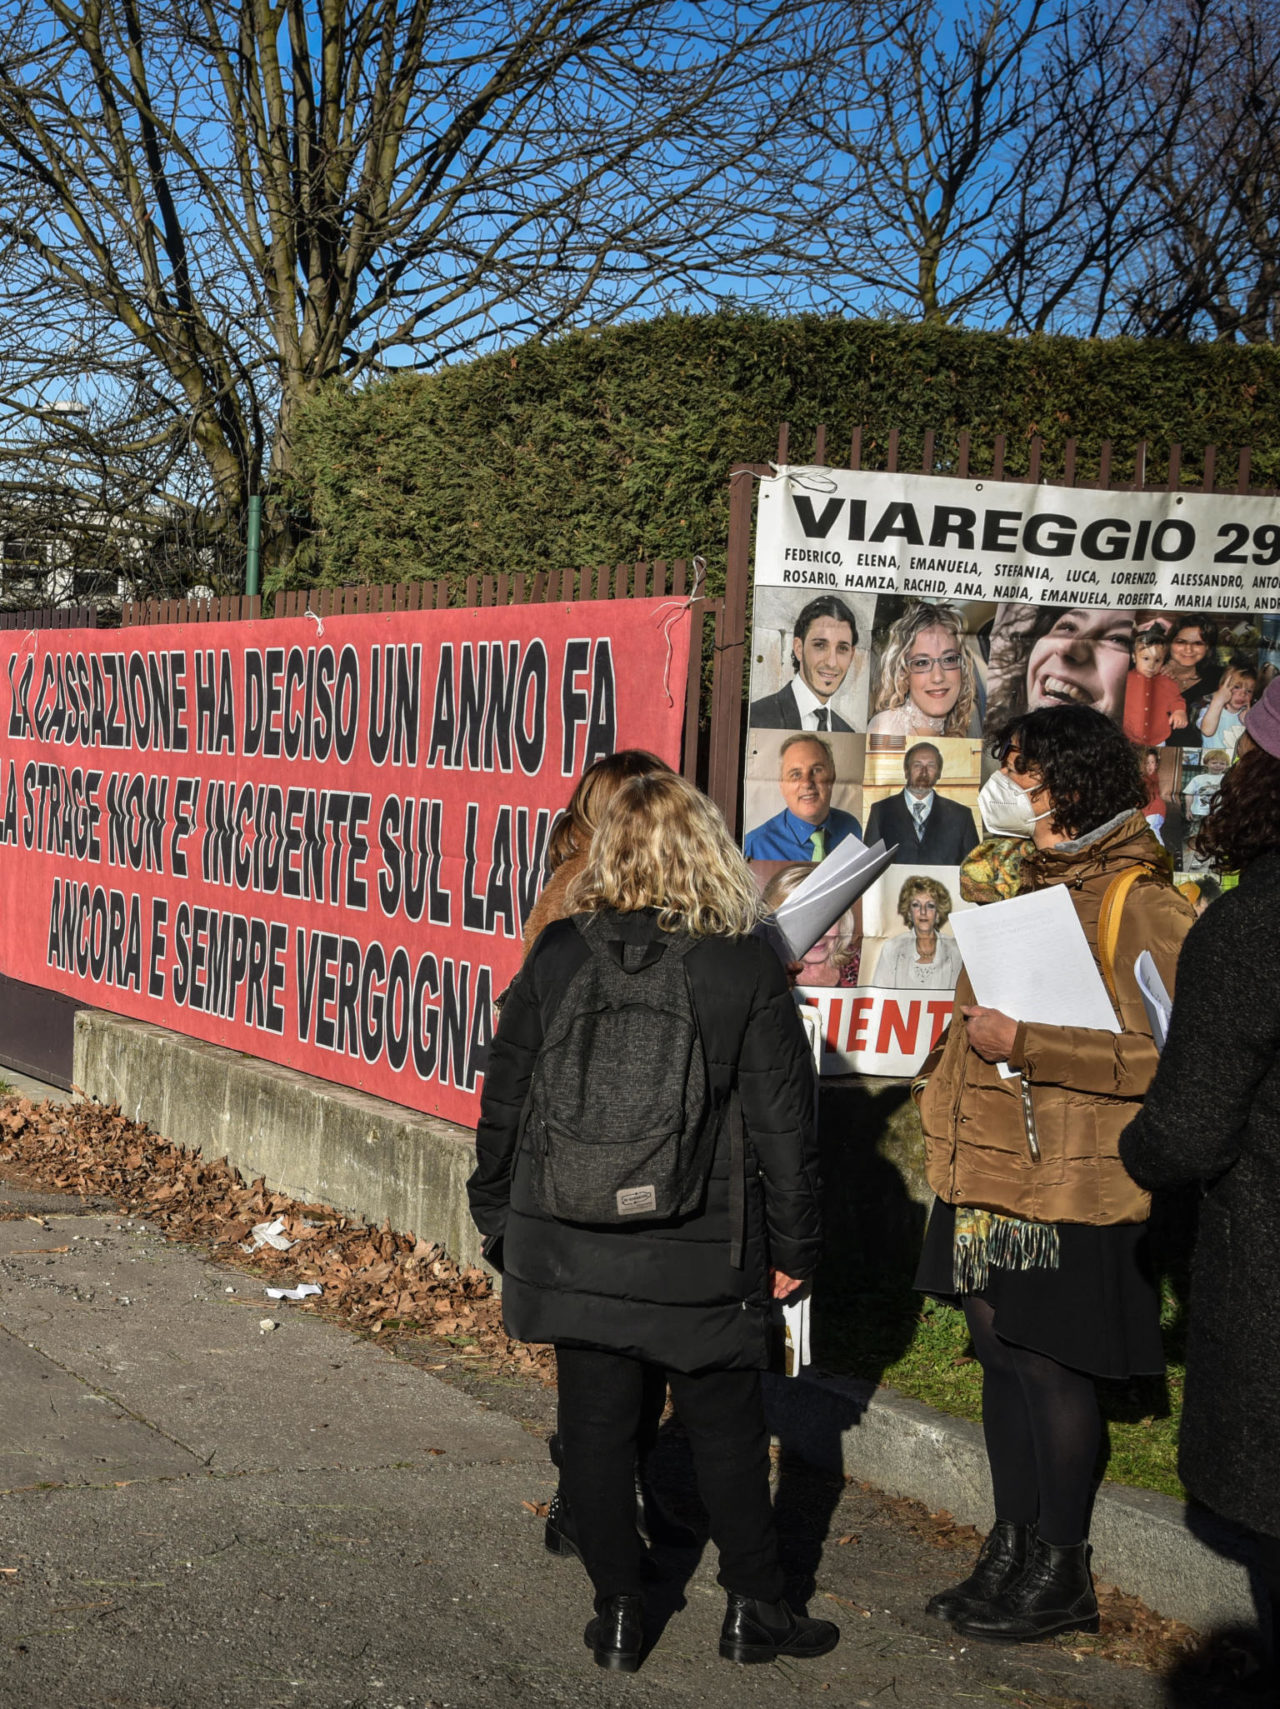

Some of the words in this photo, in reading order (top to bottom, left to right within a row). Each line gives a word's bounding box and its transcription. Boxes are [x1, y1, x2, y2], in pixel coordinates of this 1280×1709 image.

[792, 495, 1196, 562] VIAREGGIO
[1213, 523, 1280, 566] 29
[783, 570, 838, 588] ROSARIO,
[845, 574, 899, 592] HAMZA,
[903, 578, 948, 595] RACHID,
[954, 582, 987, 599] ANA,
[993, 585, 1033, 602] NADIA,
[1040, 588, 1111, 607] EMANUELA,
[1116, 593, 1168, 608] ROBERTA,
[1174, 594, 1213, 608] MARIA
[1217, 595, 1250, 610] LUISA,
[785, 548, 843, 566] FEDERICO,
[857, 553, 900, 570] ELENA,
[910, 557, 982, 576] EMANUELA,
[994, 563, 1054, 583] STEFANIA,
[1066, 569, 1100, 585] LUCA,
[1111, 571, 1158, 586] LORENZO,
[1170, 573, 1244, 589] ALESSANDRO,
[1252, 576, 1280, 589] ANTO
[8, 652, 35, 740] LA
[34, 650, 188, 753] CASSAZIONE
[194, 649, 235, 756] HA
[243, 643, 360, 765] DECISO
[368, 643, 422, 767] UN
[426, 637, 548, 776] ANNO
[561, 637, 616, 777] FA
[23, 760, 104, 864] STRAGE
[106, 772, 169, 875] NON
[170, 777, 201, 878] E'
[202, 779, 371, 911] INCIDENTE
[377, 794, 451, 926] SUL
[462, 802, 566, 940] LAV
[47, 876, 141, 994] ANCORA
[148, 897, 168, 999] E
[172, 901, 288, 1036] SEMPRE
[297, 927, 495, 1094] VERGOGNA
[806, 997, 955, 1055] IENT
